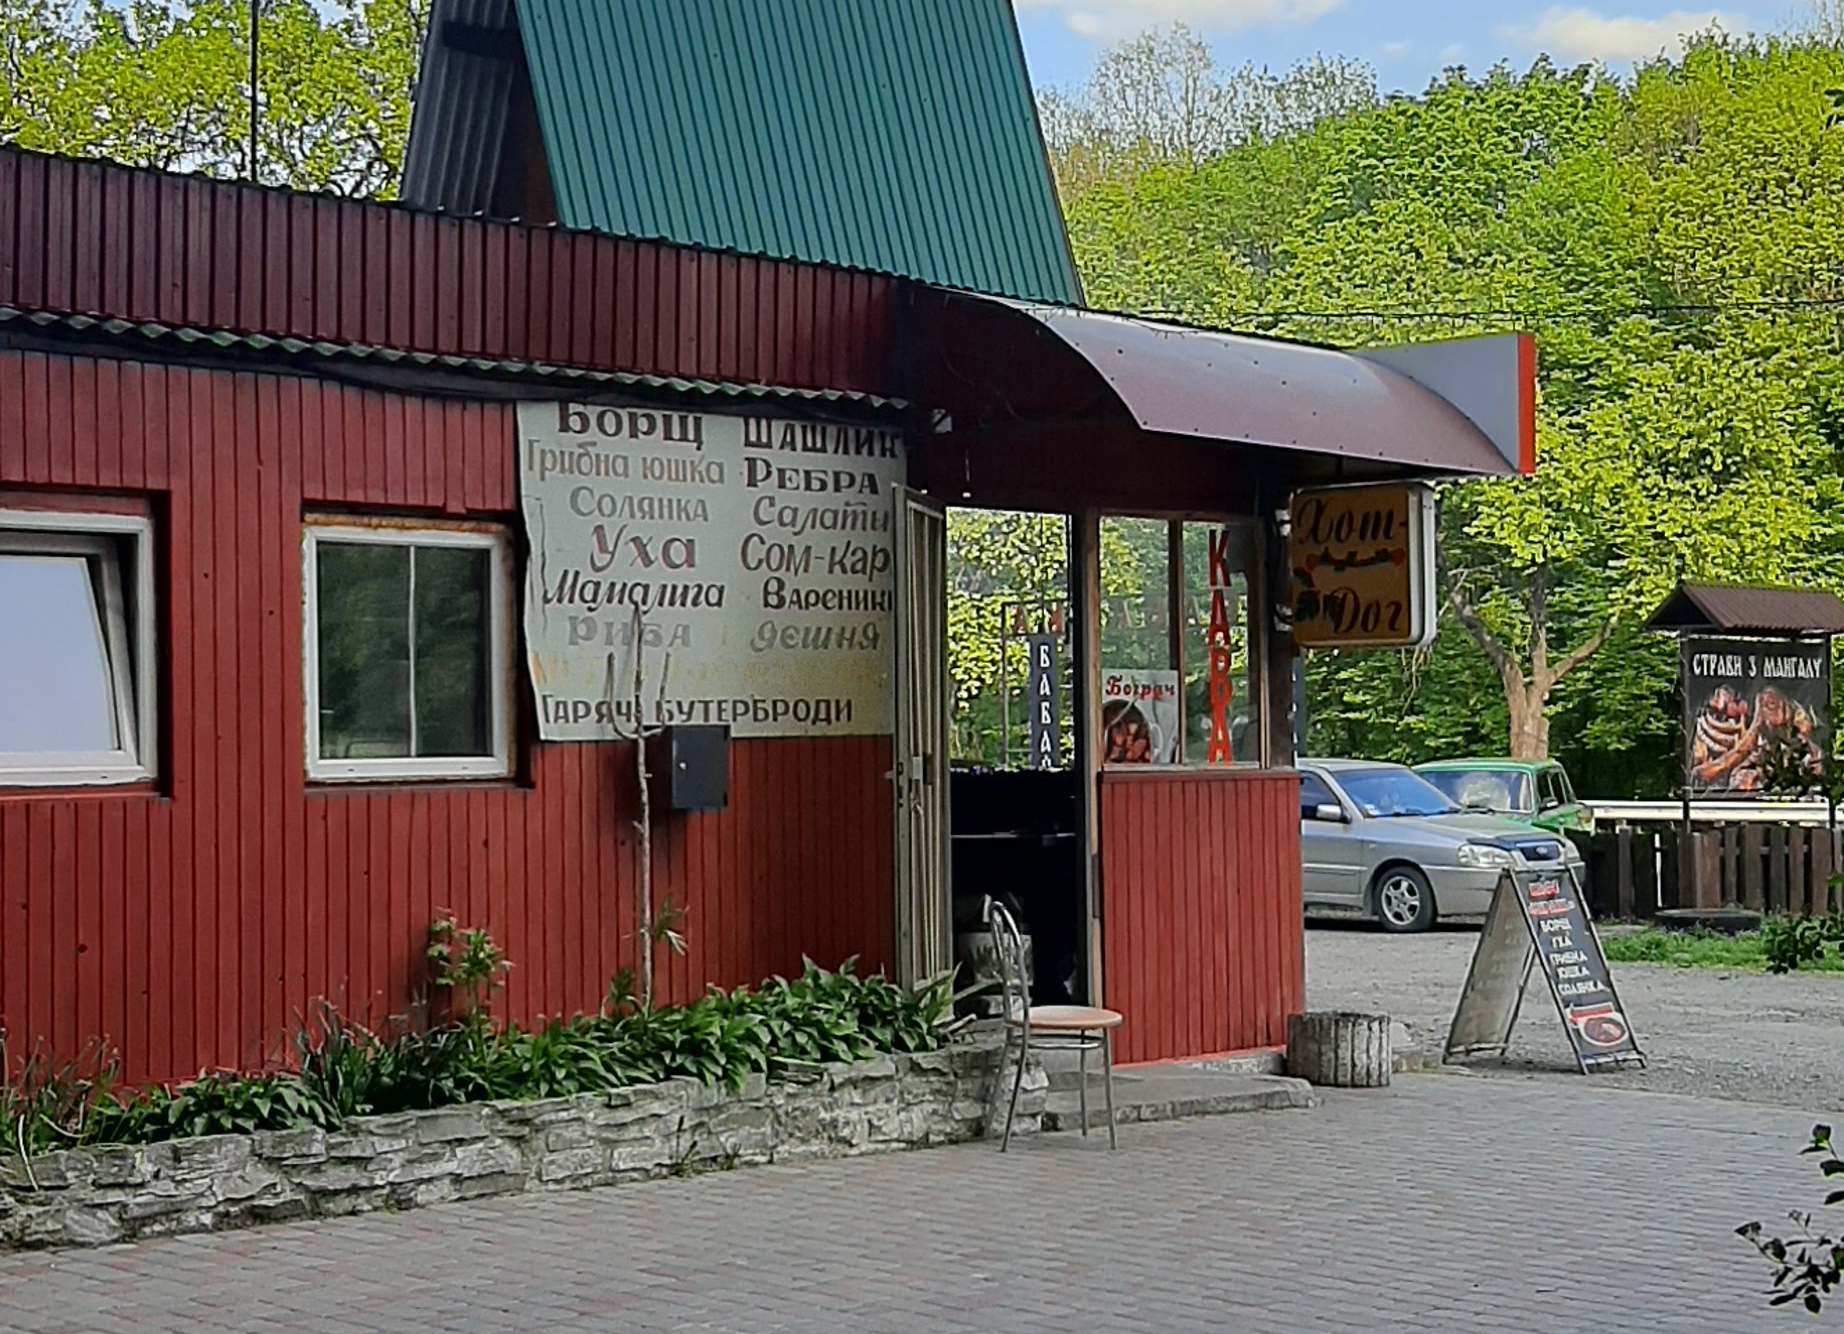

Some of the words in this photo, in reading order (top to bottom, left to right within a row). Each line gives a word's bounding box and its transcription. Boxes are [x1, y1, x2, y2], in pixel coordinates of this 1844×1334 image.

[528, 440, 629, 482] Грибна
[641, 454, 726, 485] юшка
[753, 495, 889, 536] Салати
[544, 570, 725, 613] Мамалига
[1208, 529, 1232, 763] КАВА
[1692, 653, 1742, 676] СТРАВИ
[1763, 656, 1822, 678] МАНГАЛУ
[542, 694, 642, 724] ГАРЯЧ
[655, 698, 852, 725] БУТЕРБРОДИ
